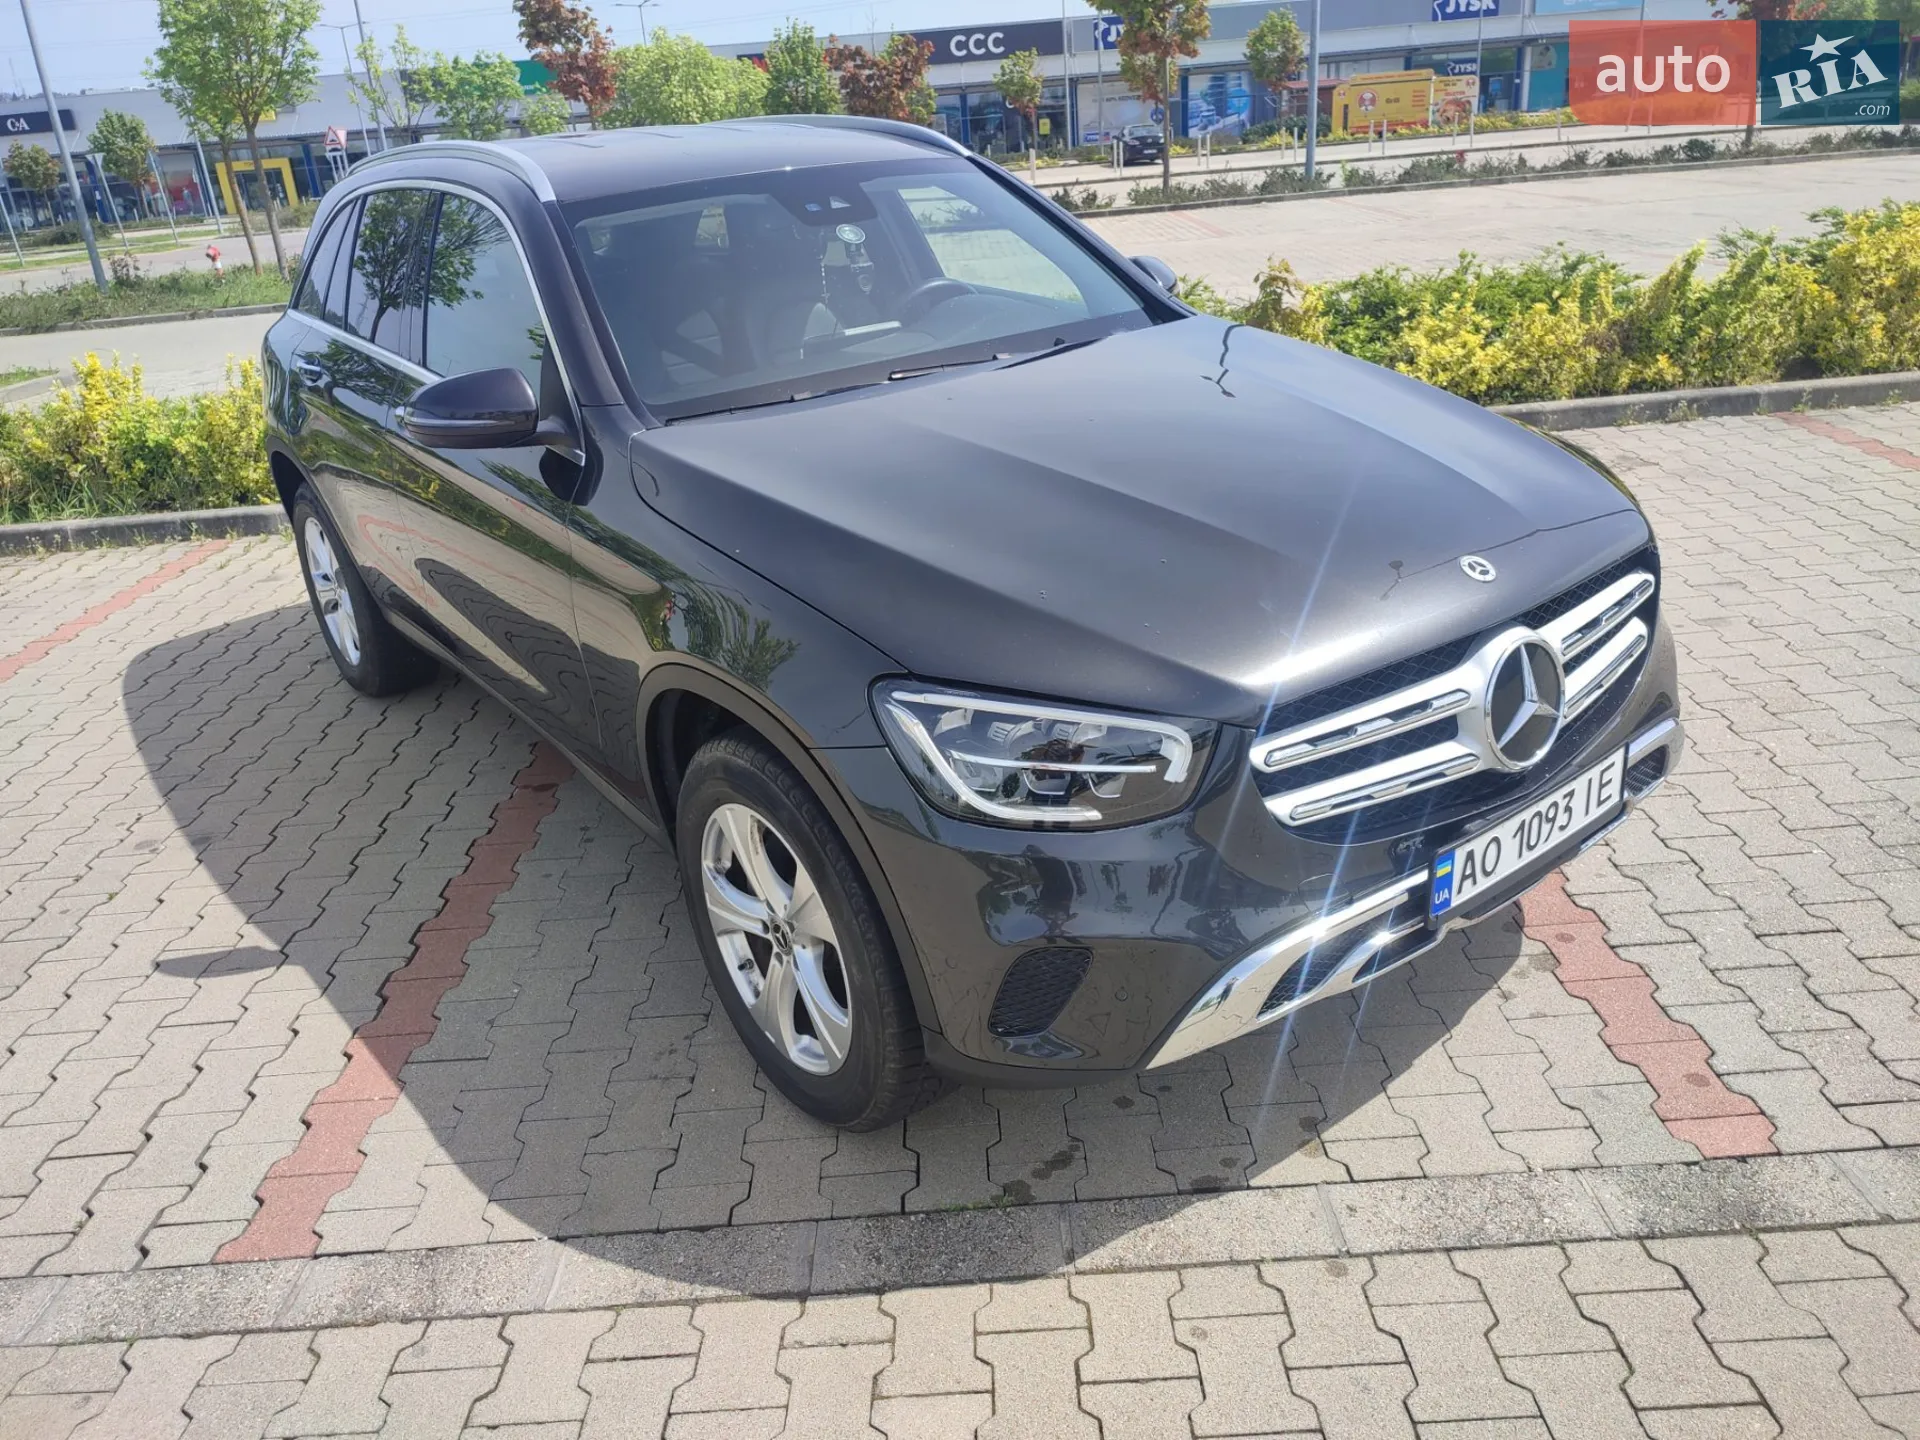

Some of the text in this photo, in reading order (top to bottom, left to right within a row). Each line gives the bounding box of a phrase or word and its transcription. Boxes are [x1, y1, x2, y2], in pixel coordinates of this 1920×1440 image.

[949, 31, 1005, 57] CCC
[6, 117, 30, 131] C&A
[1457, 761, 1616, 895] AO 1093 IE
[1434, 889, 1450, 905] UA
